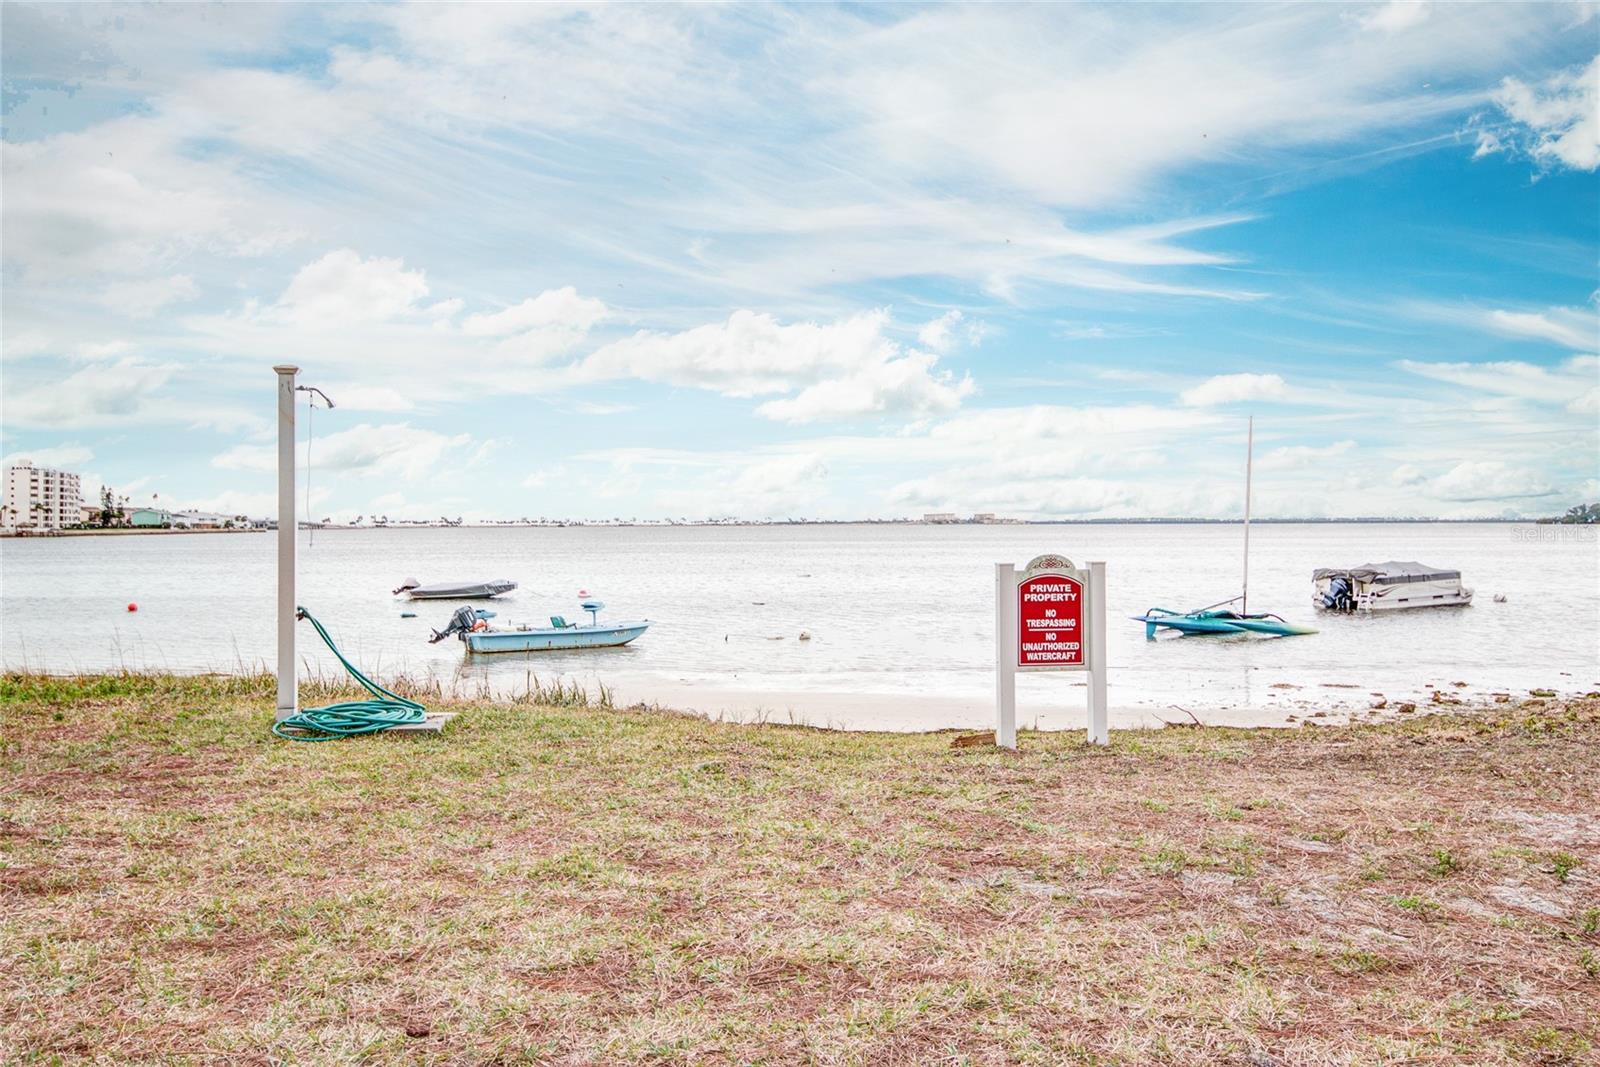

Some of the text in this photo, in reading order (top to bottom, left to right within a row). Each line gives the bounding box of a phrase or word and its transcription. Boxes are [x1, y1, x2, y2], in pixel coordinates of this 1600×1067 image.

[1030, 584, 1072, 592] PRIVATE
[1024, 593, 1077, 602] PROPERTY
[1045, 609, 1057, 617] NO
[1026, 619, 1076, 627] TRESPASSING
[1022, 642, 1080, 651] UNAUTHORIZED
[1026, 652, 1076, 660] WATERCRAFT
